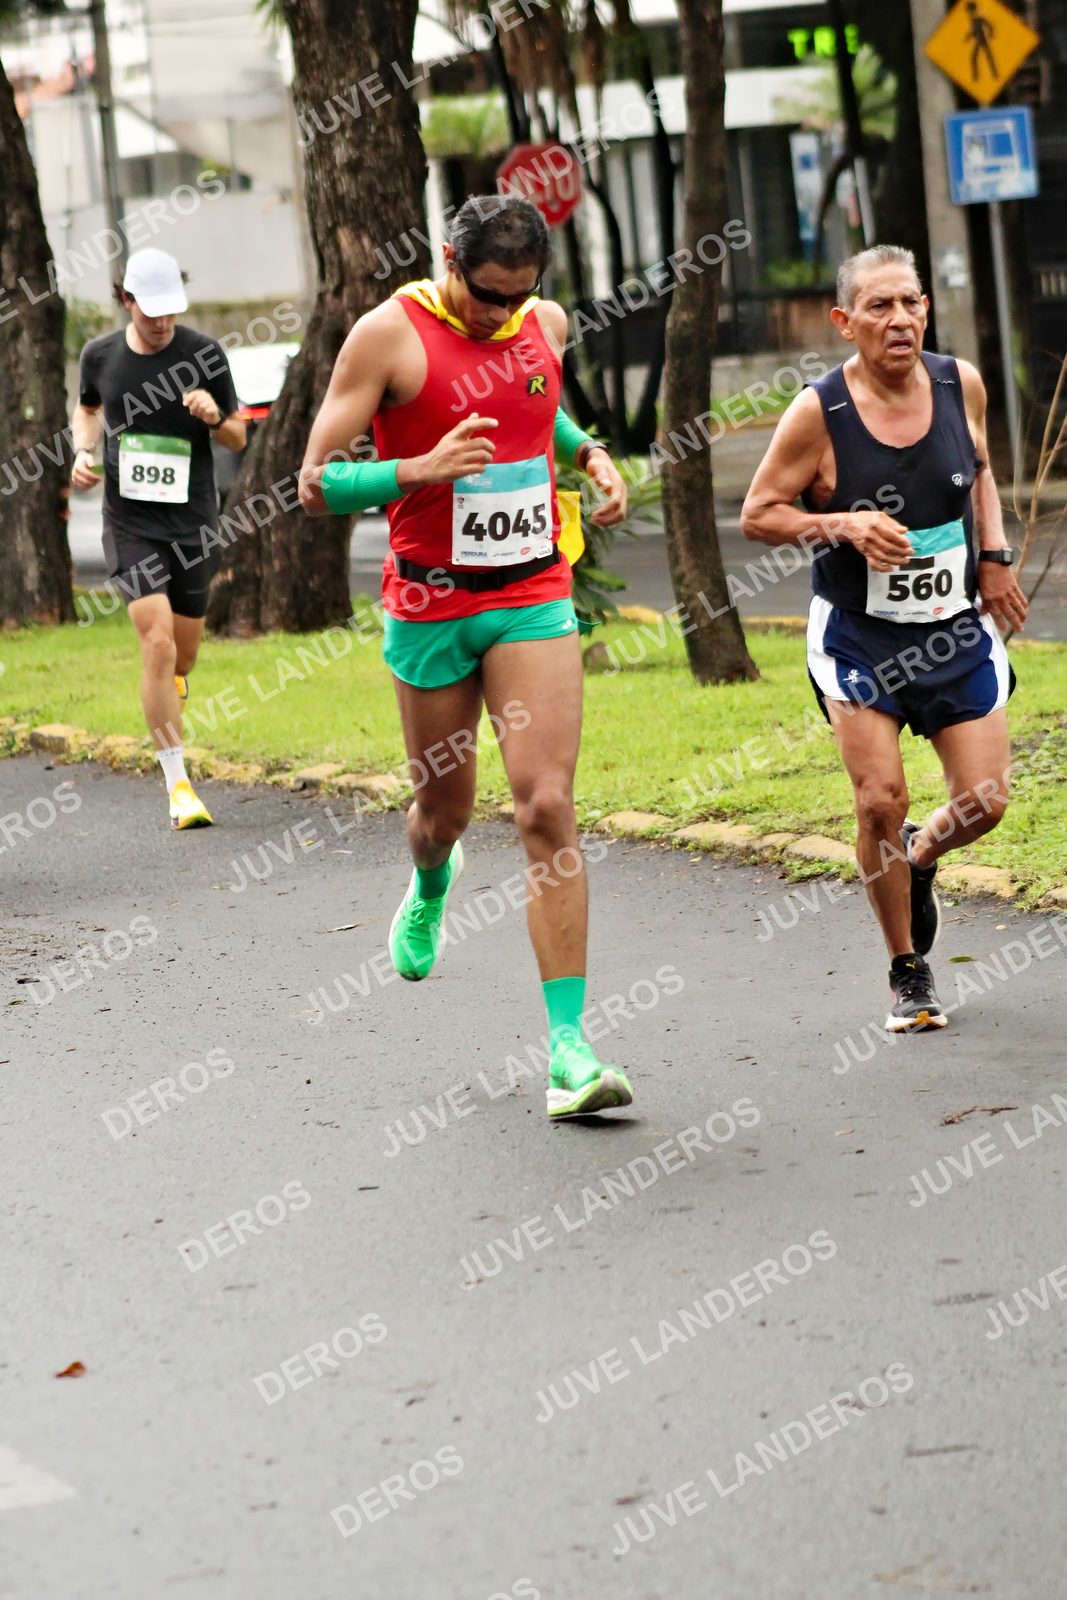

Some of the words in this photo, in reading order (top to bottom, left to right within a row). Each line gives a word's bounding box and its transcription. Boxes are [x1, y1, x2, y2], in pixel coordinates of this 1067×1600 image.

[529, 374, 546, 396] R
[131, 465, 176, 485] 898
[462, 503, 547, 541] 4045
[886, 568, 953, 602] 560
